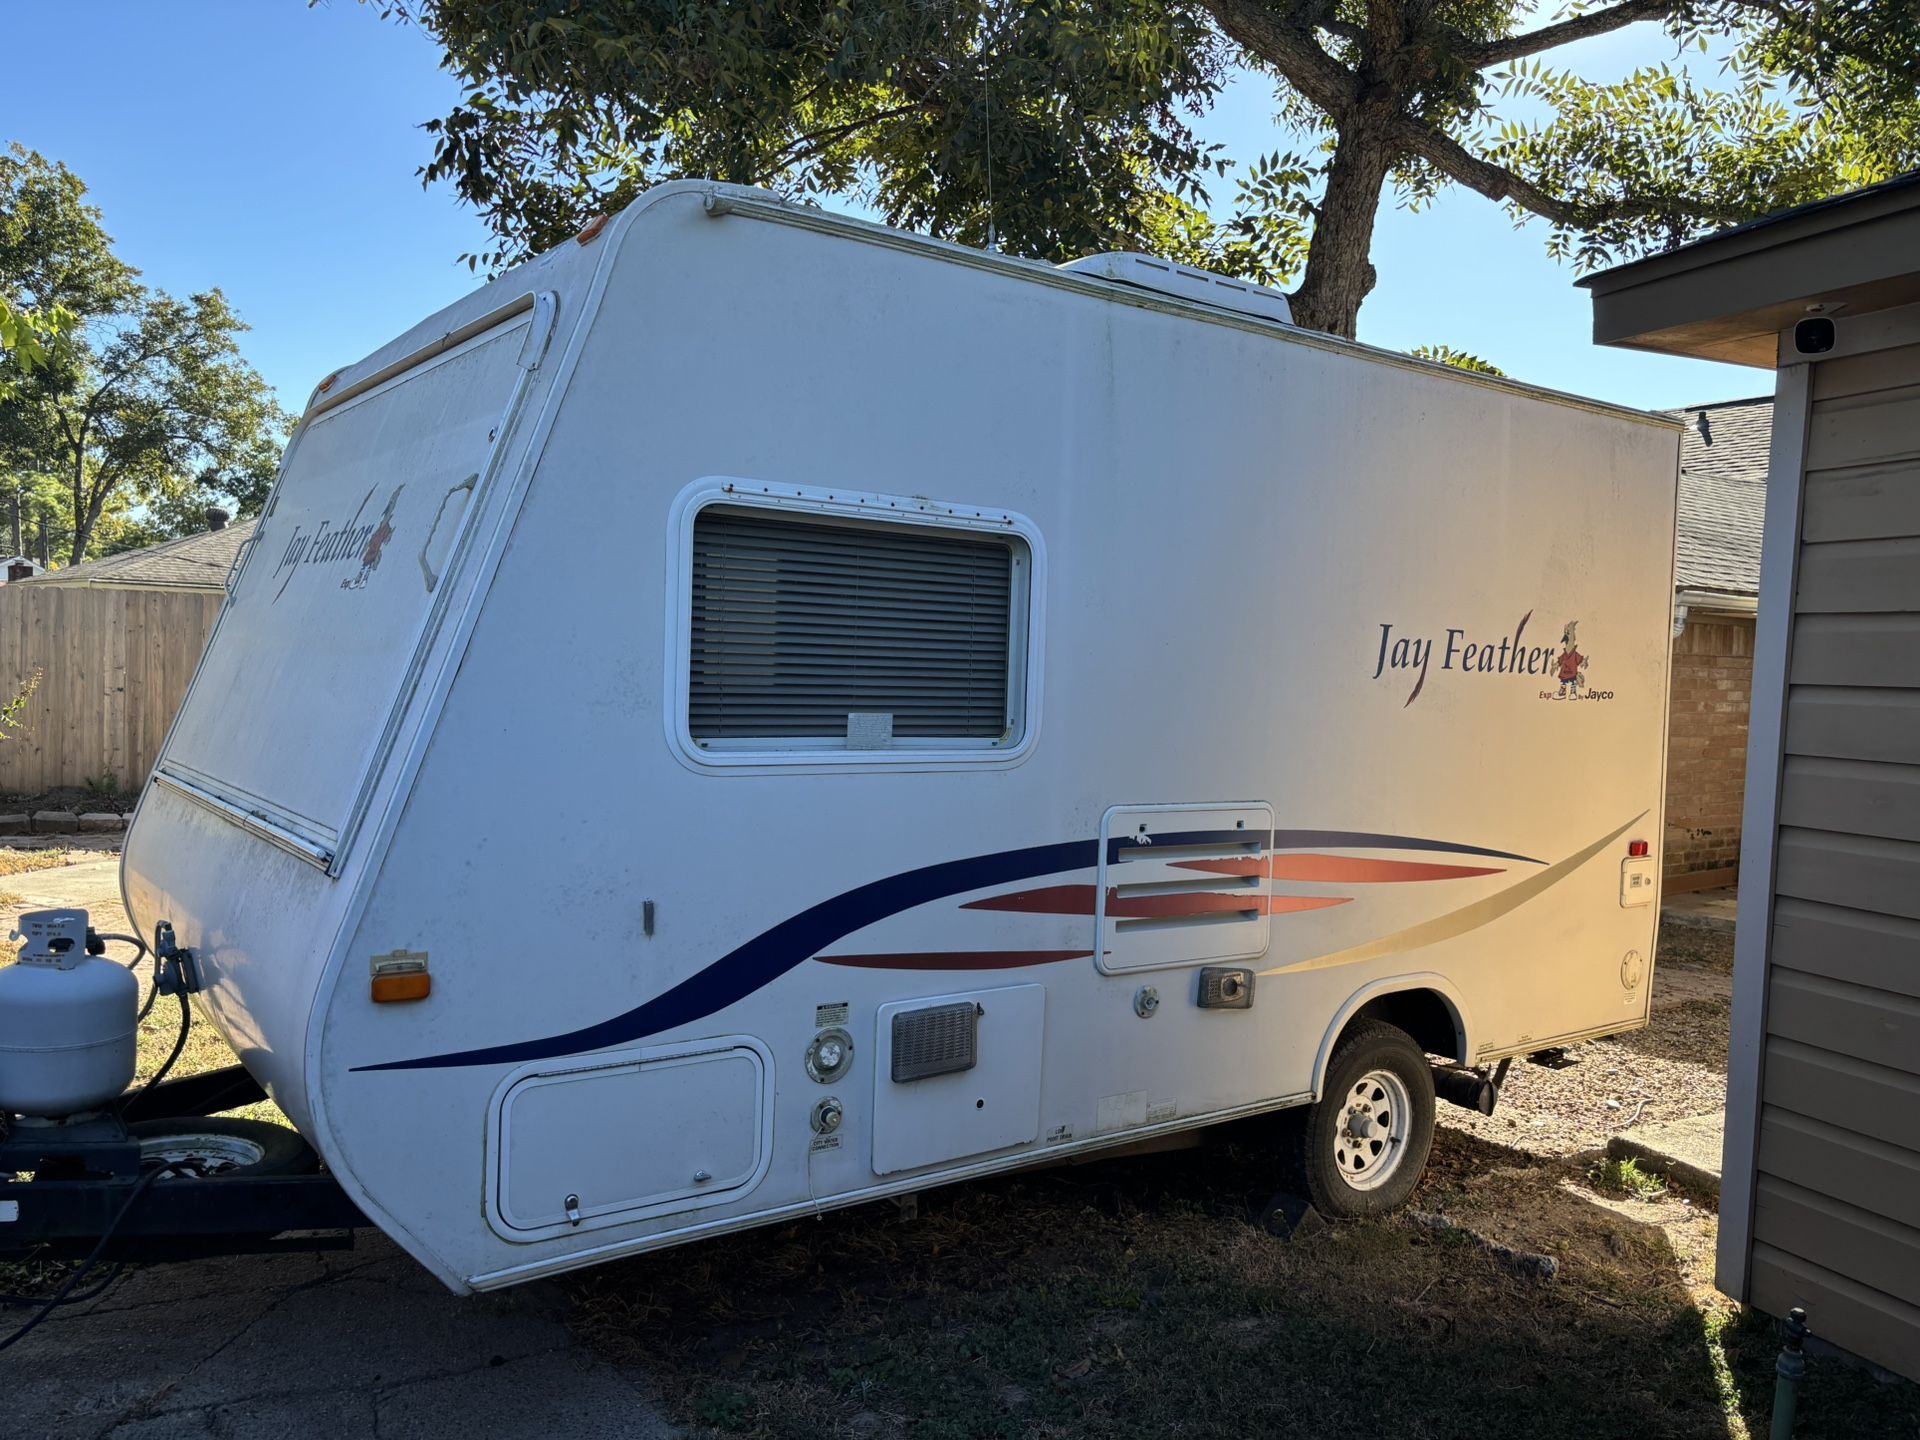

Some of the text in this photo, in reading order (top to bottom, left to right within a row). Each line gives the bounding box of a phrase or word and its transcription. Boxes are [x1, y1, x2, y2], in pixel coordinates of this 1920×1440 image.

[272, 482, 379, 605] Jay Feather
[1372, 609, 1555, 710] Jay Feather
[1585, 688, 1614, 702] Jayco
